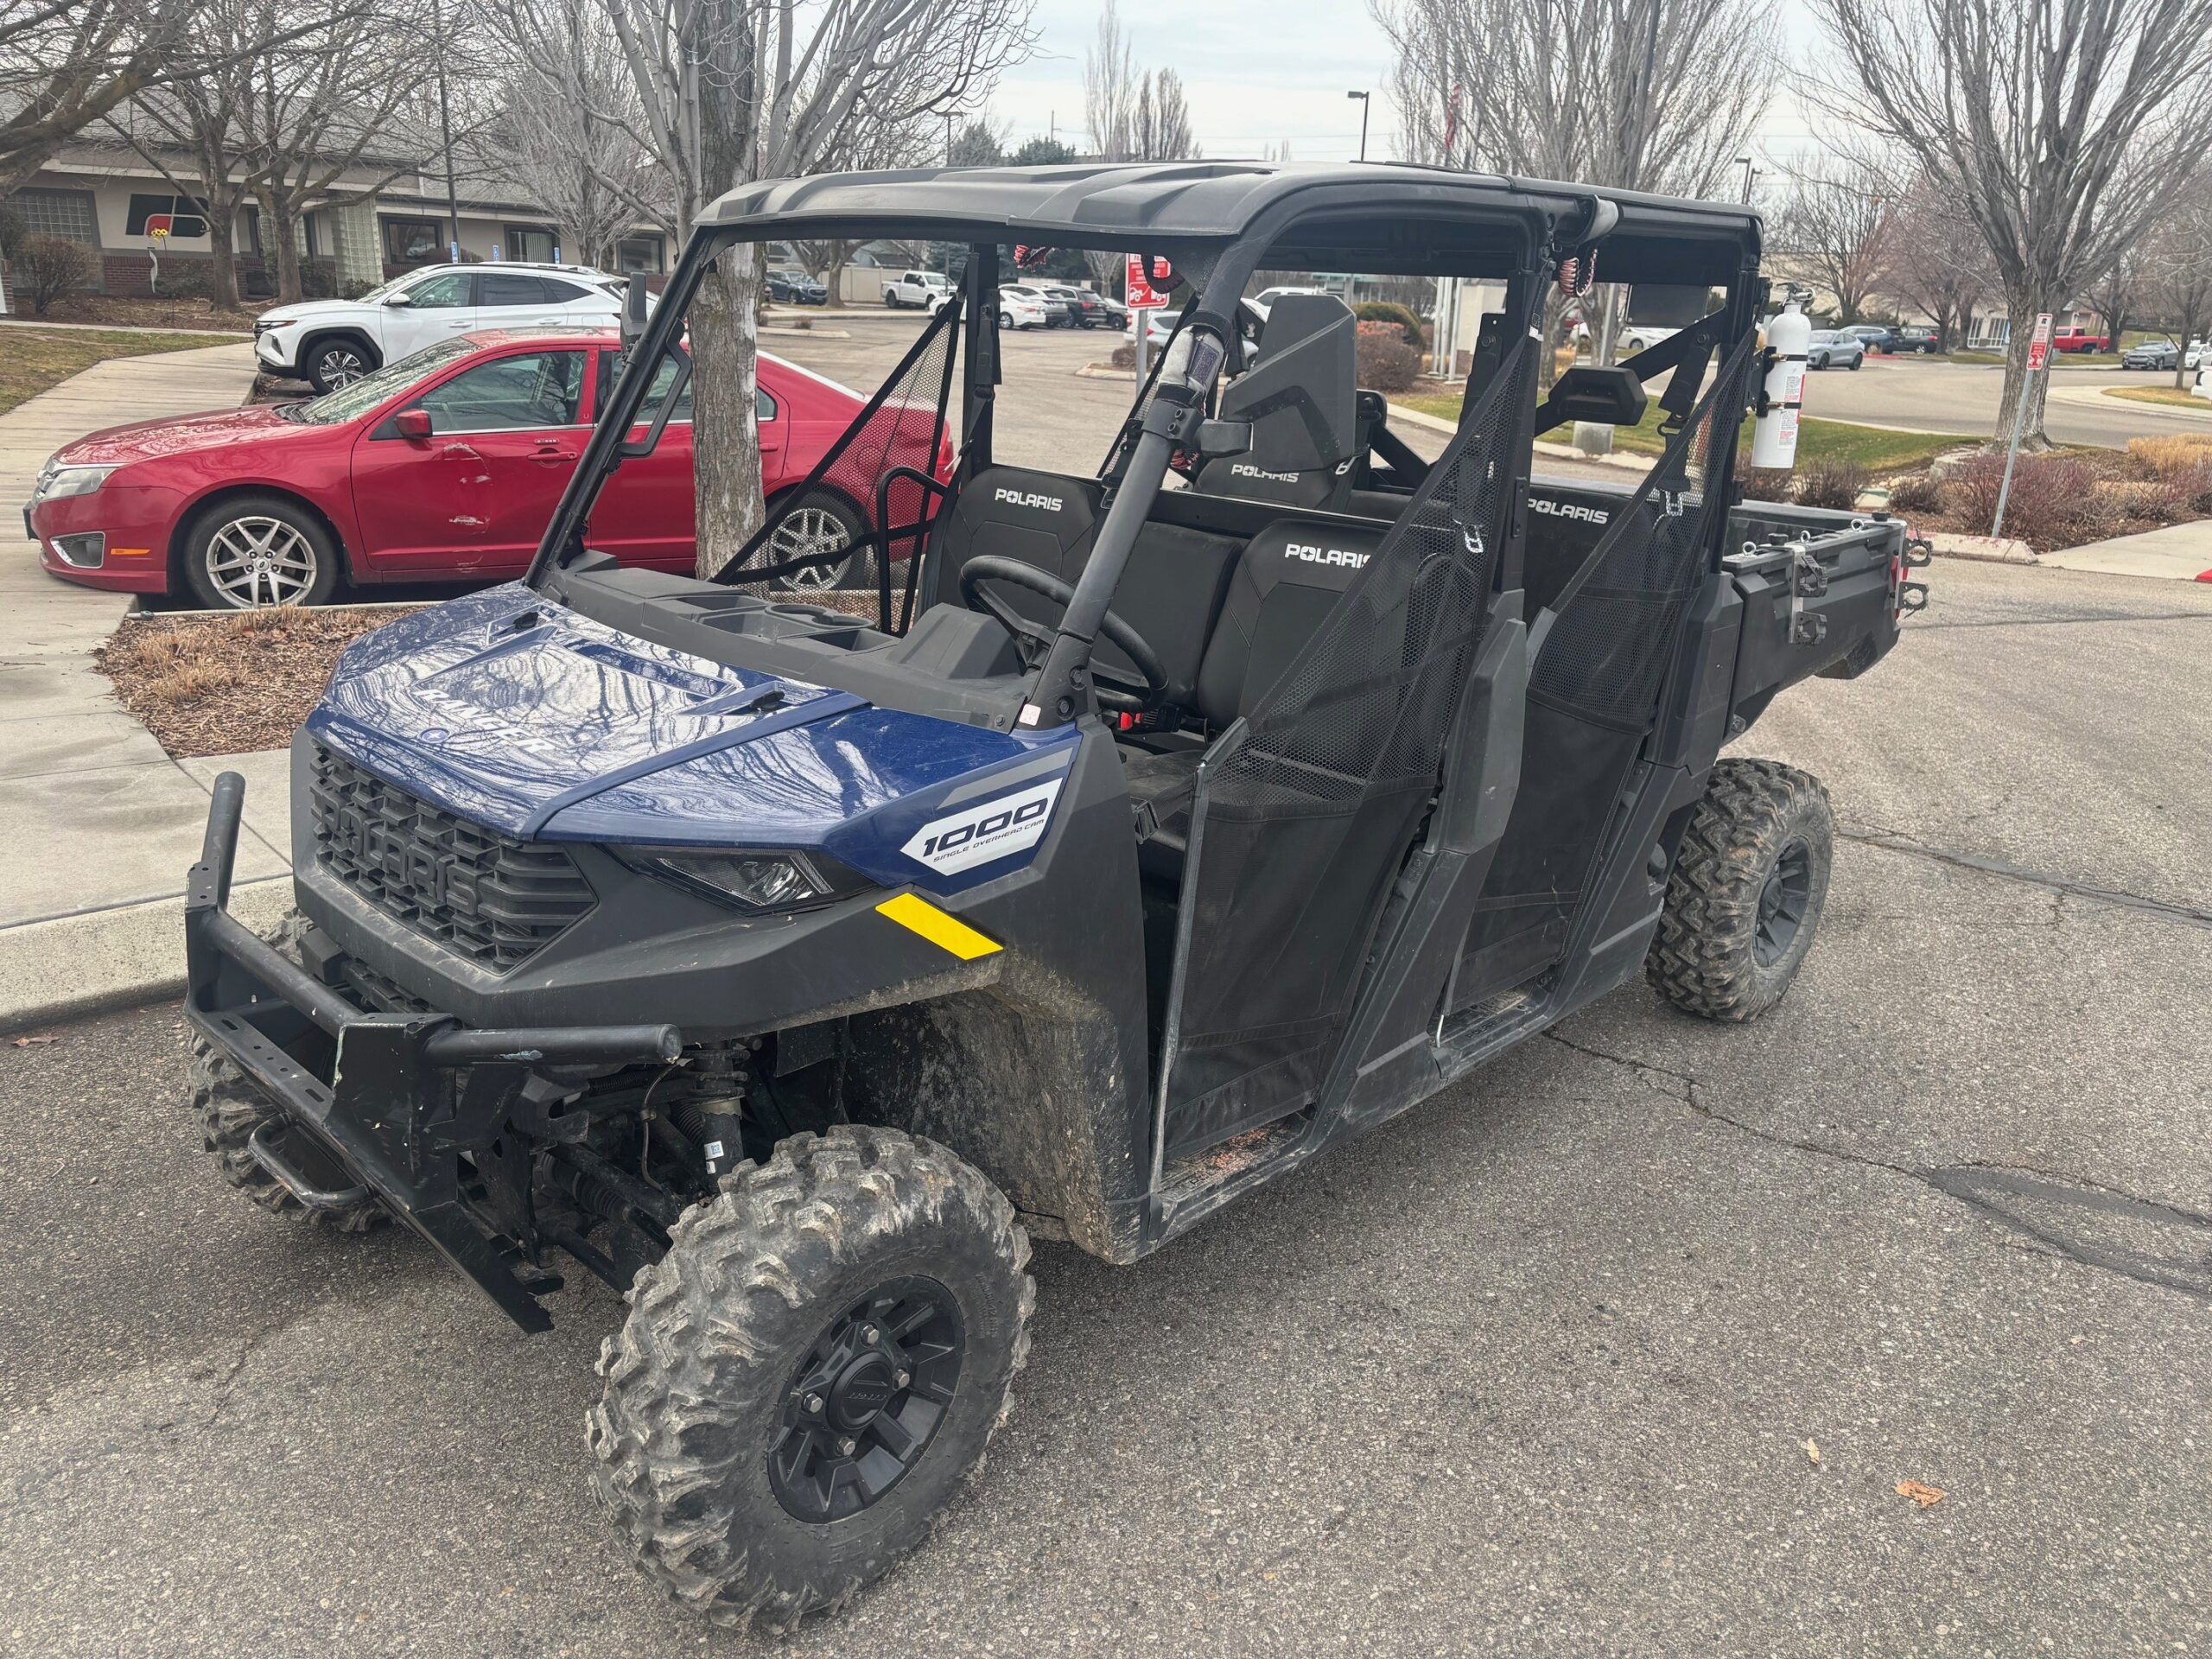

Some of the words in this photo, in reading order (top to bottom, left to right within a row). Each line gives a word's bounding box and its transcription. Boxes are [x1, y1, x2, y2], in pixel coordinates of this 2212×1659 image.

[995, 487, 1063, 512] POLARIS
[411, 689, 556, 753] RANGER
[314, 781, 483, 916] POLARIS
[923, 797, 1048, 857] 1000
[933, 845, 969, 862] SINGLE
[973, 826, 1022, 848] OVERHEAD
[1024, 818, 1045, 830] CAM
